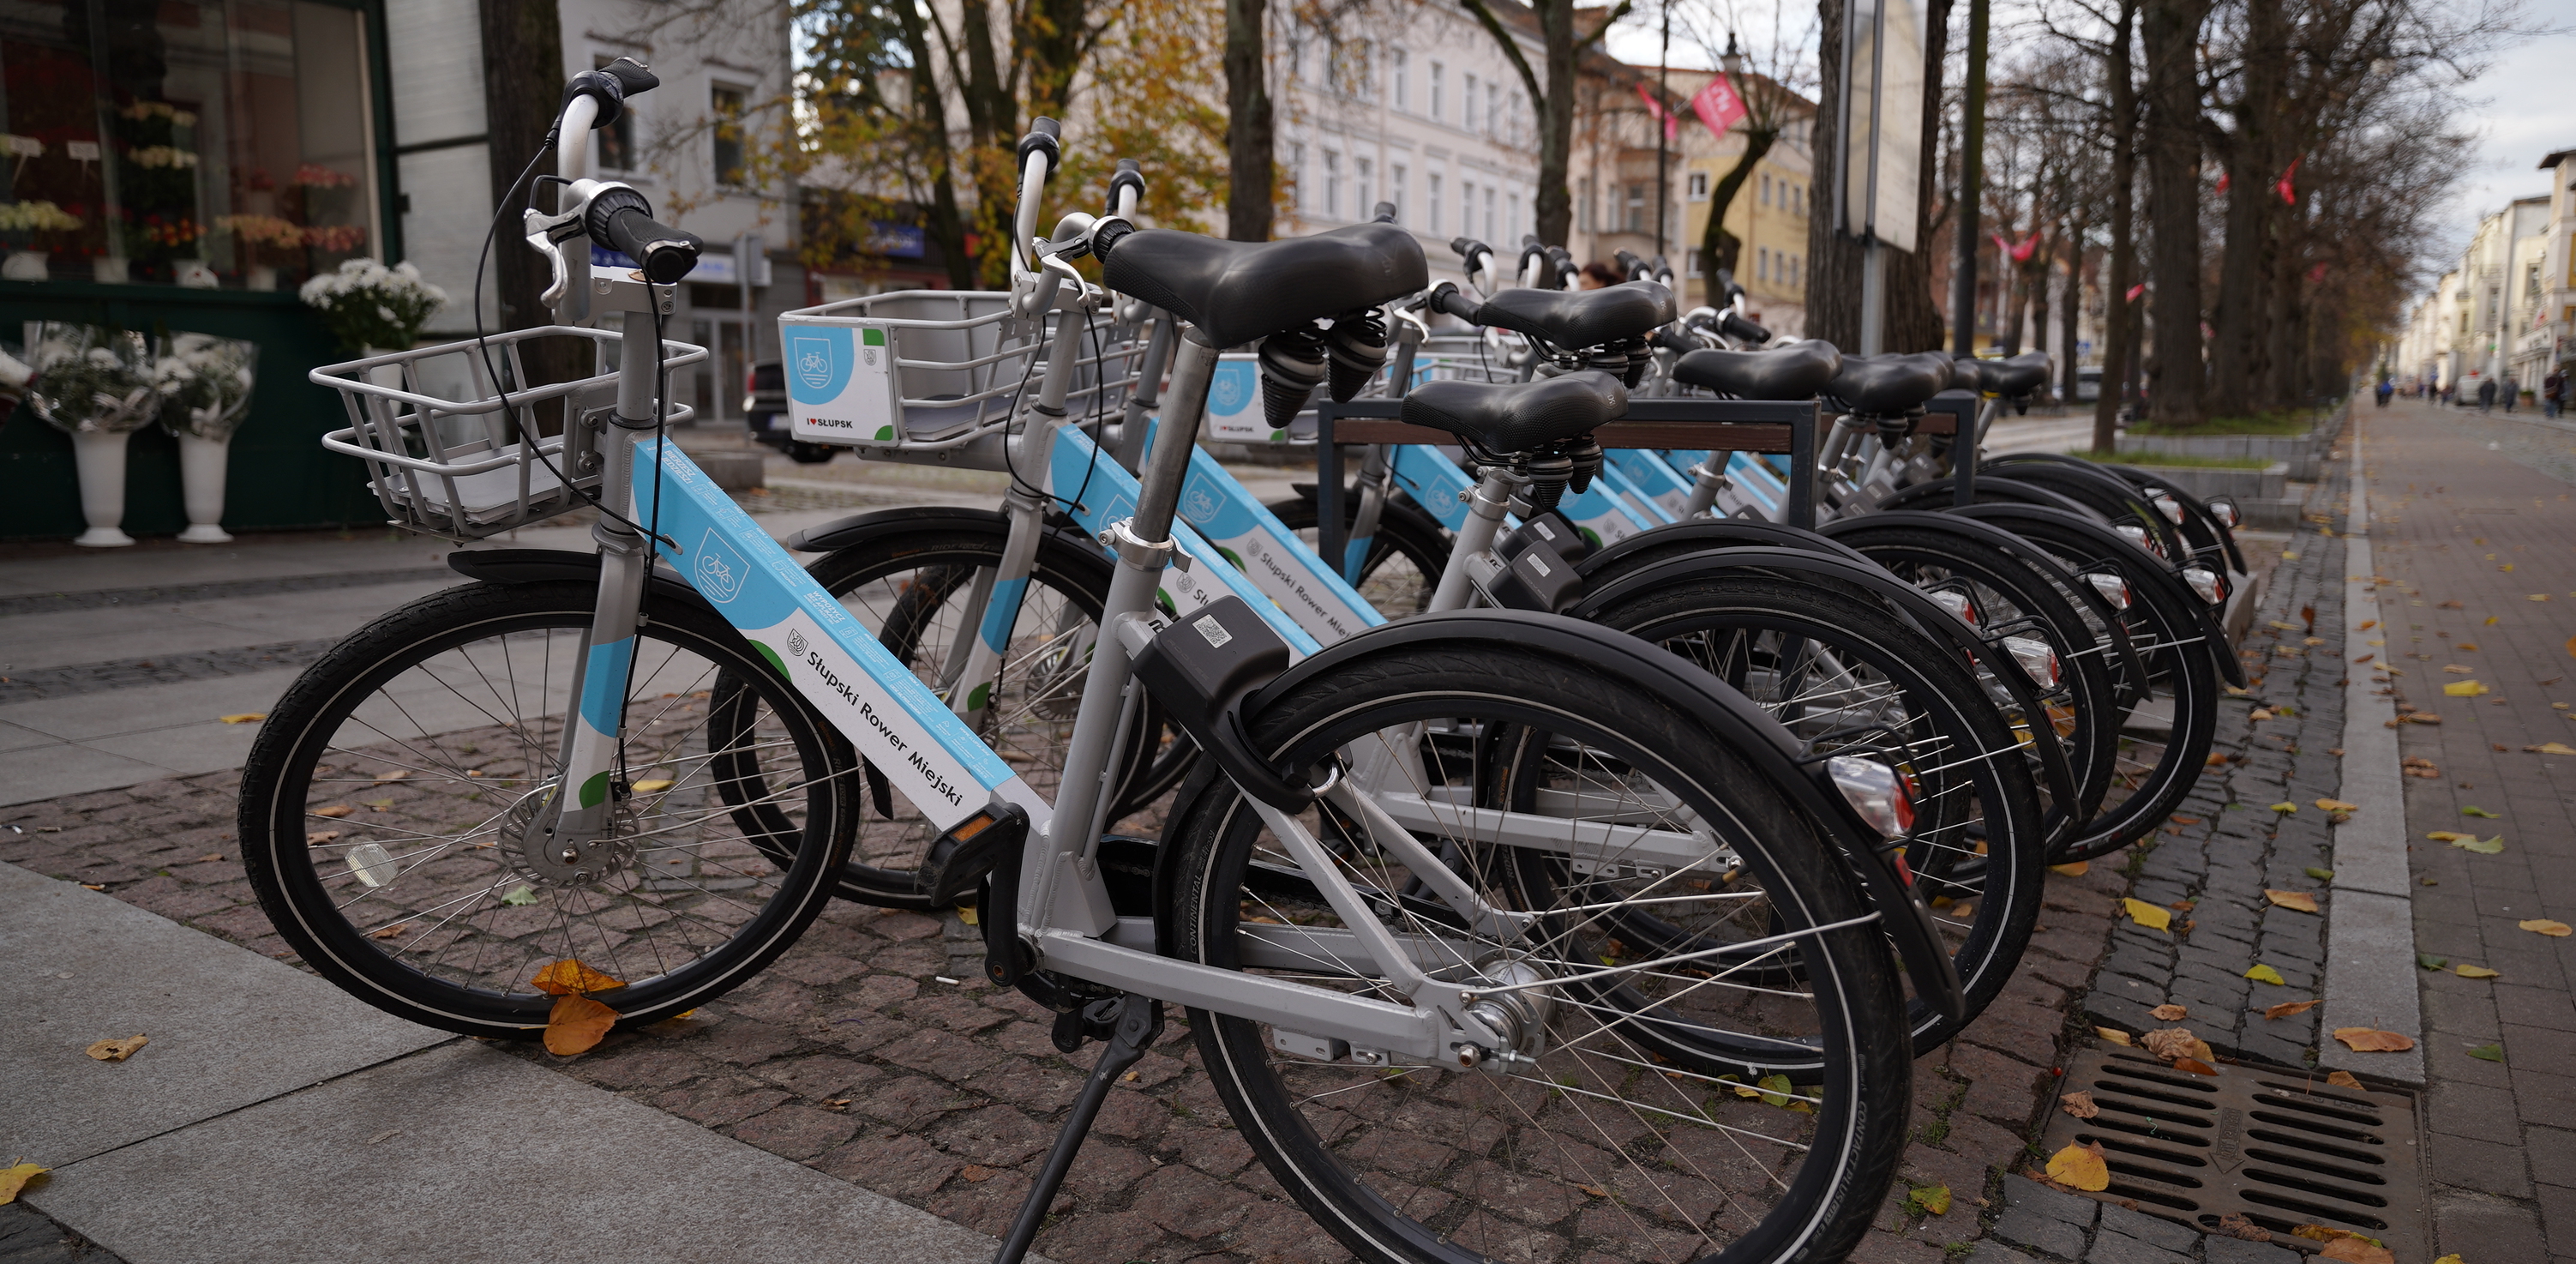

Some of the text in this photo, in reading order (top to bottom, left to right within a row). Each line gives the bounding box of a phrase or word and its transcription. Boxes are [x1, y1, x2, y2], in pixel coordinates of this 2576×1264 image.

[818, 418, 853, 429] SŁUPSK
[664, 449, 696, 477] BIERZESZ
[811, 590, 847, 621] WYPOŻYCZ
[1260, 552, 1297, 588] Słupski
[1295, 586, 1328, 617] Rower
[808, 652, 859, 707] Słupski
[859, 701, 907, 751] Rower
[908, 751, 964, 807] Miejski
[1190, 875, 1202, 954] CONTINENTAL
[1852, 1100, 1868, 1170] CONTACT
[1838, 1167, 1854, 1204] PLUS
